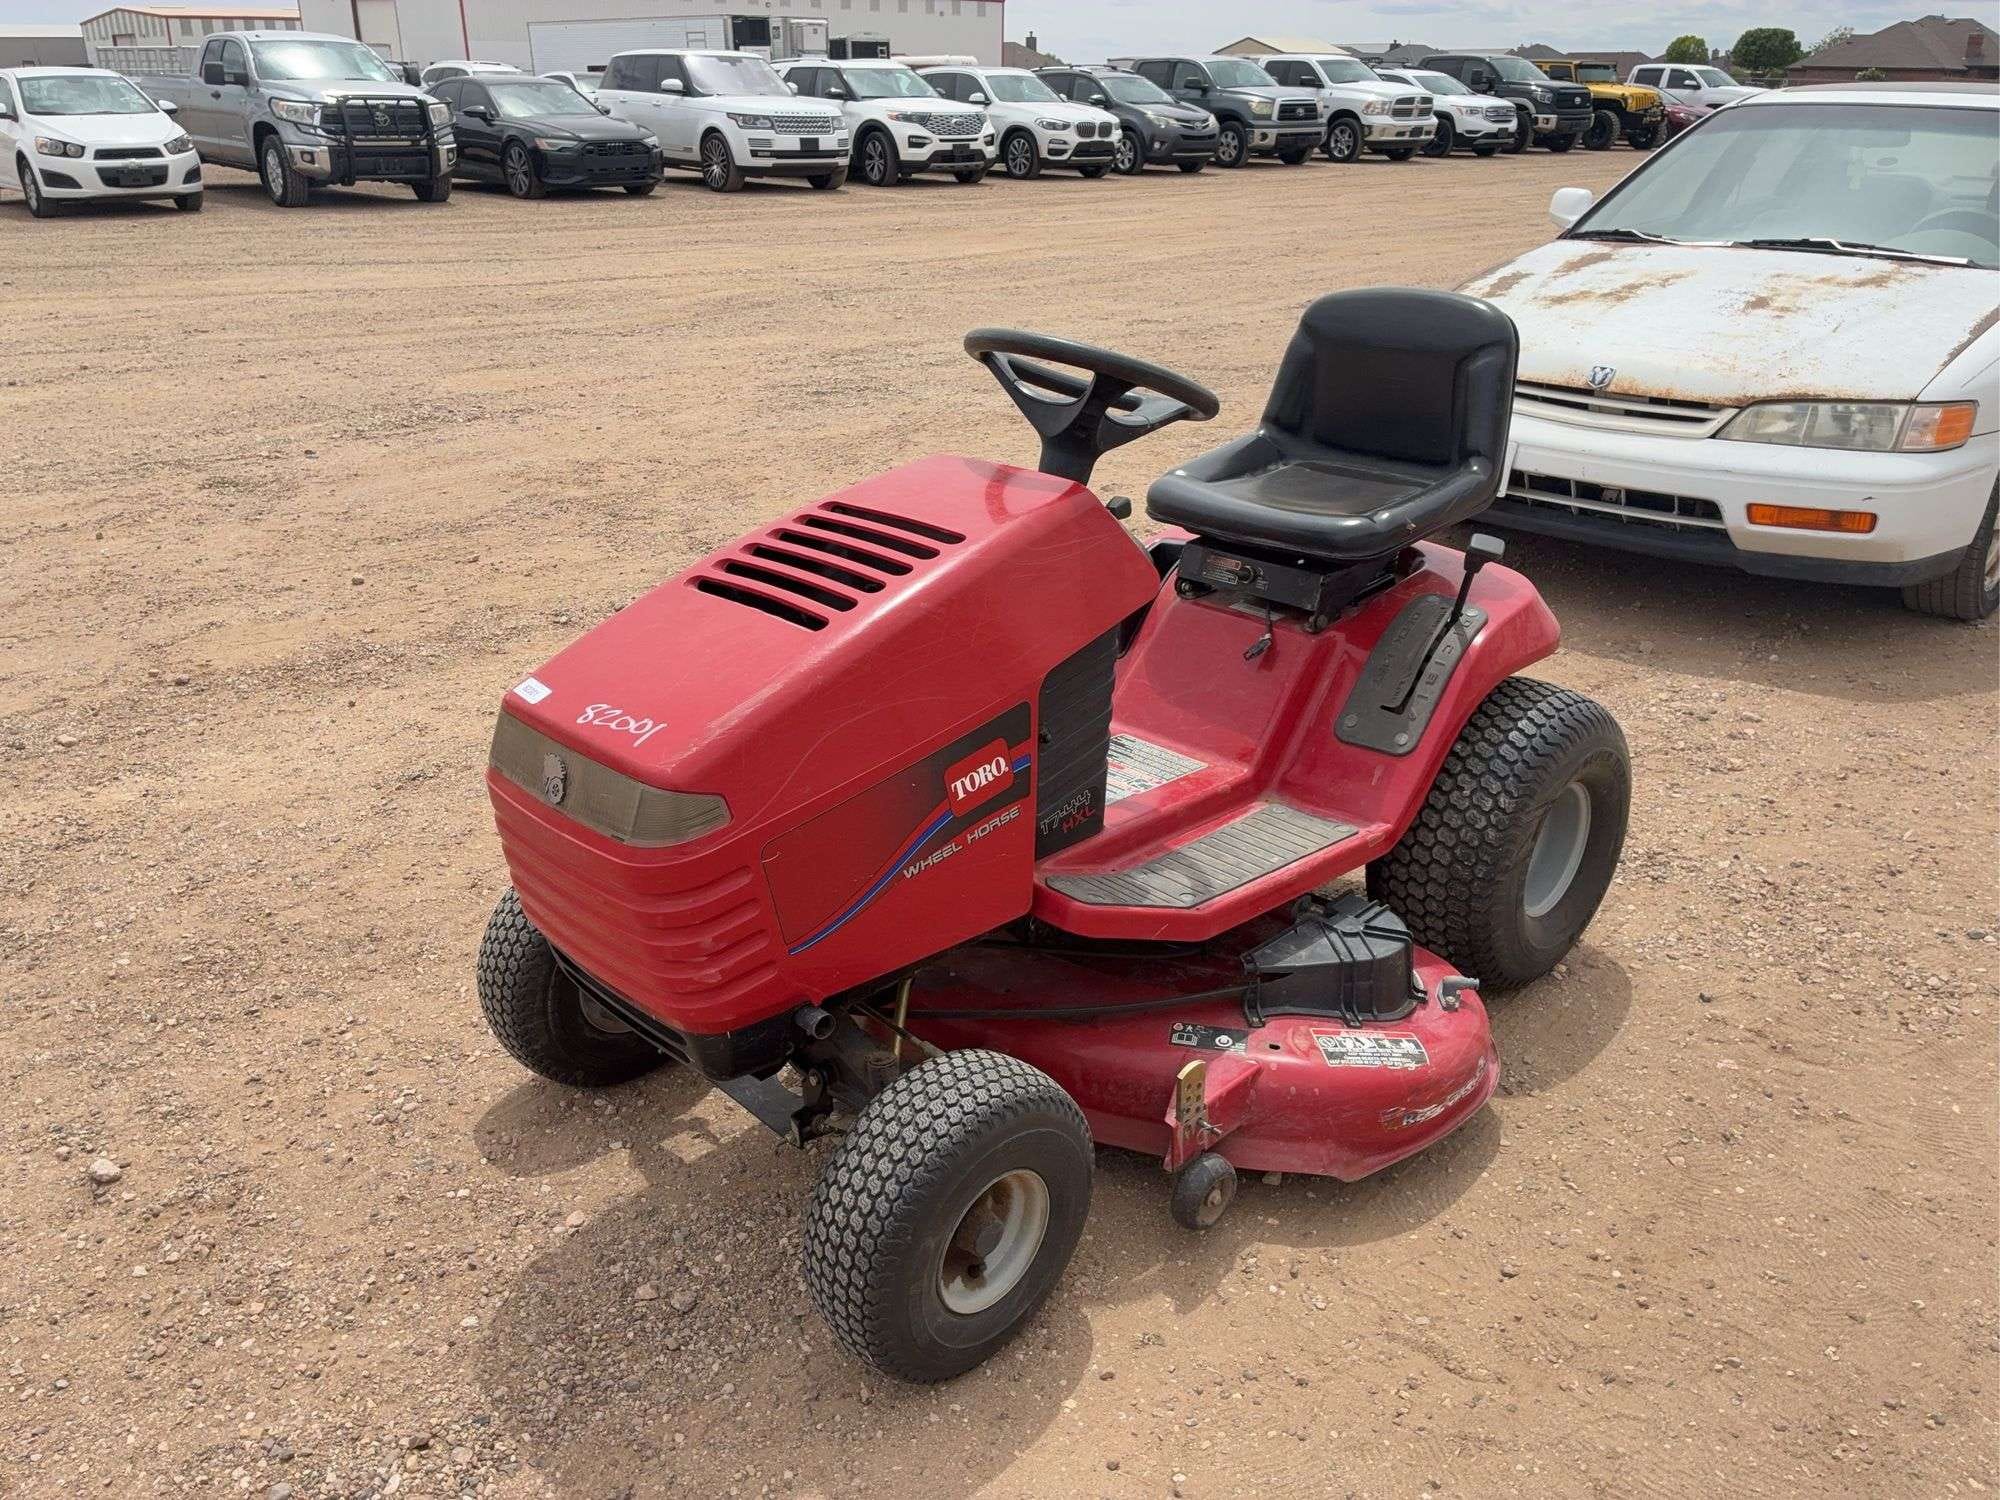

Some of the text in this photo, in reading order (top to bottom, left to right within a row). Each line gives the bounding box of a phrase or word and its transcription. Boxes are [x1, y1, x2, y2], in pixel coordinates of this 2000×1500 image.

[576, 703, 668, 747] 82001
[951, 757, 1007, 801] TORO
[1040, 790, 1091, 834] 17-44
[1062, 806, 1096, 833] HXL
[903, 805, 1020, 878] WHEEL HORSE
